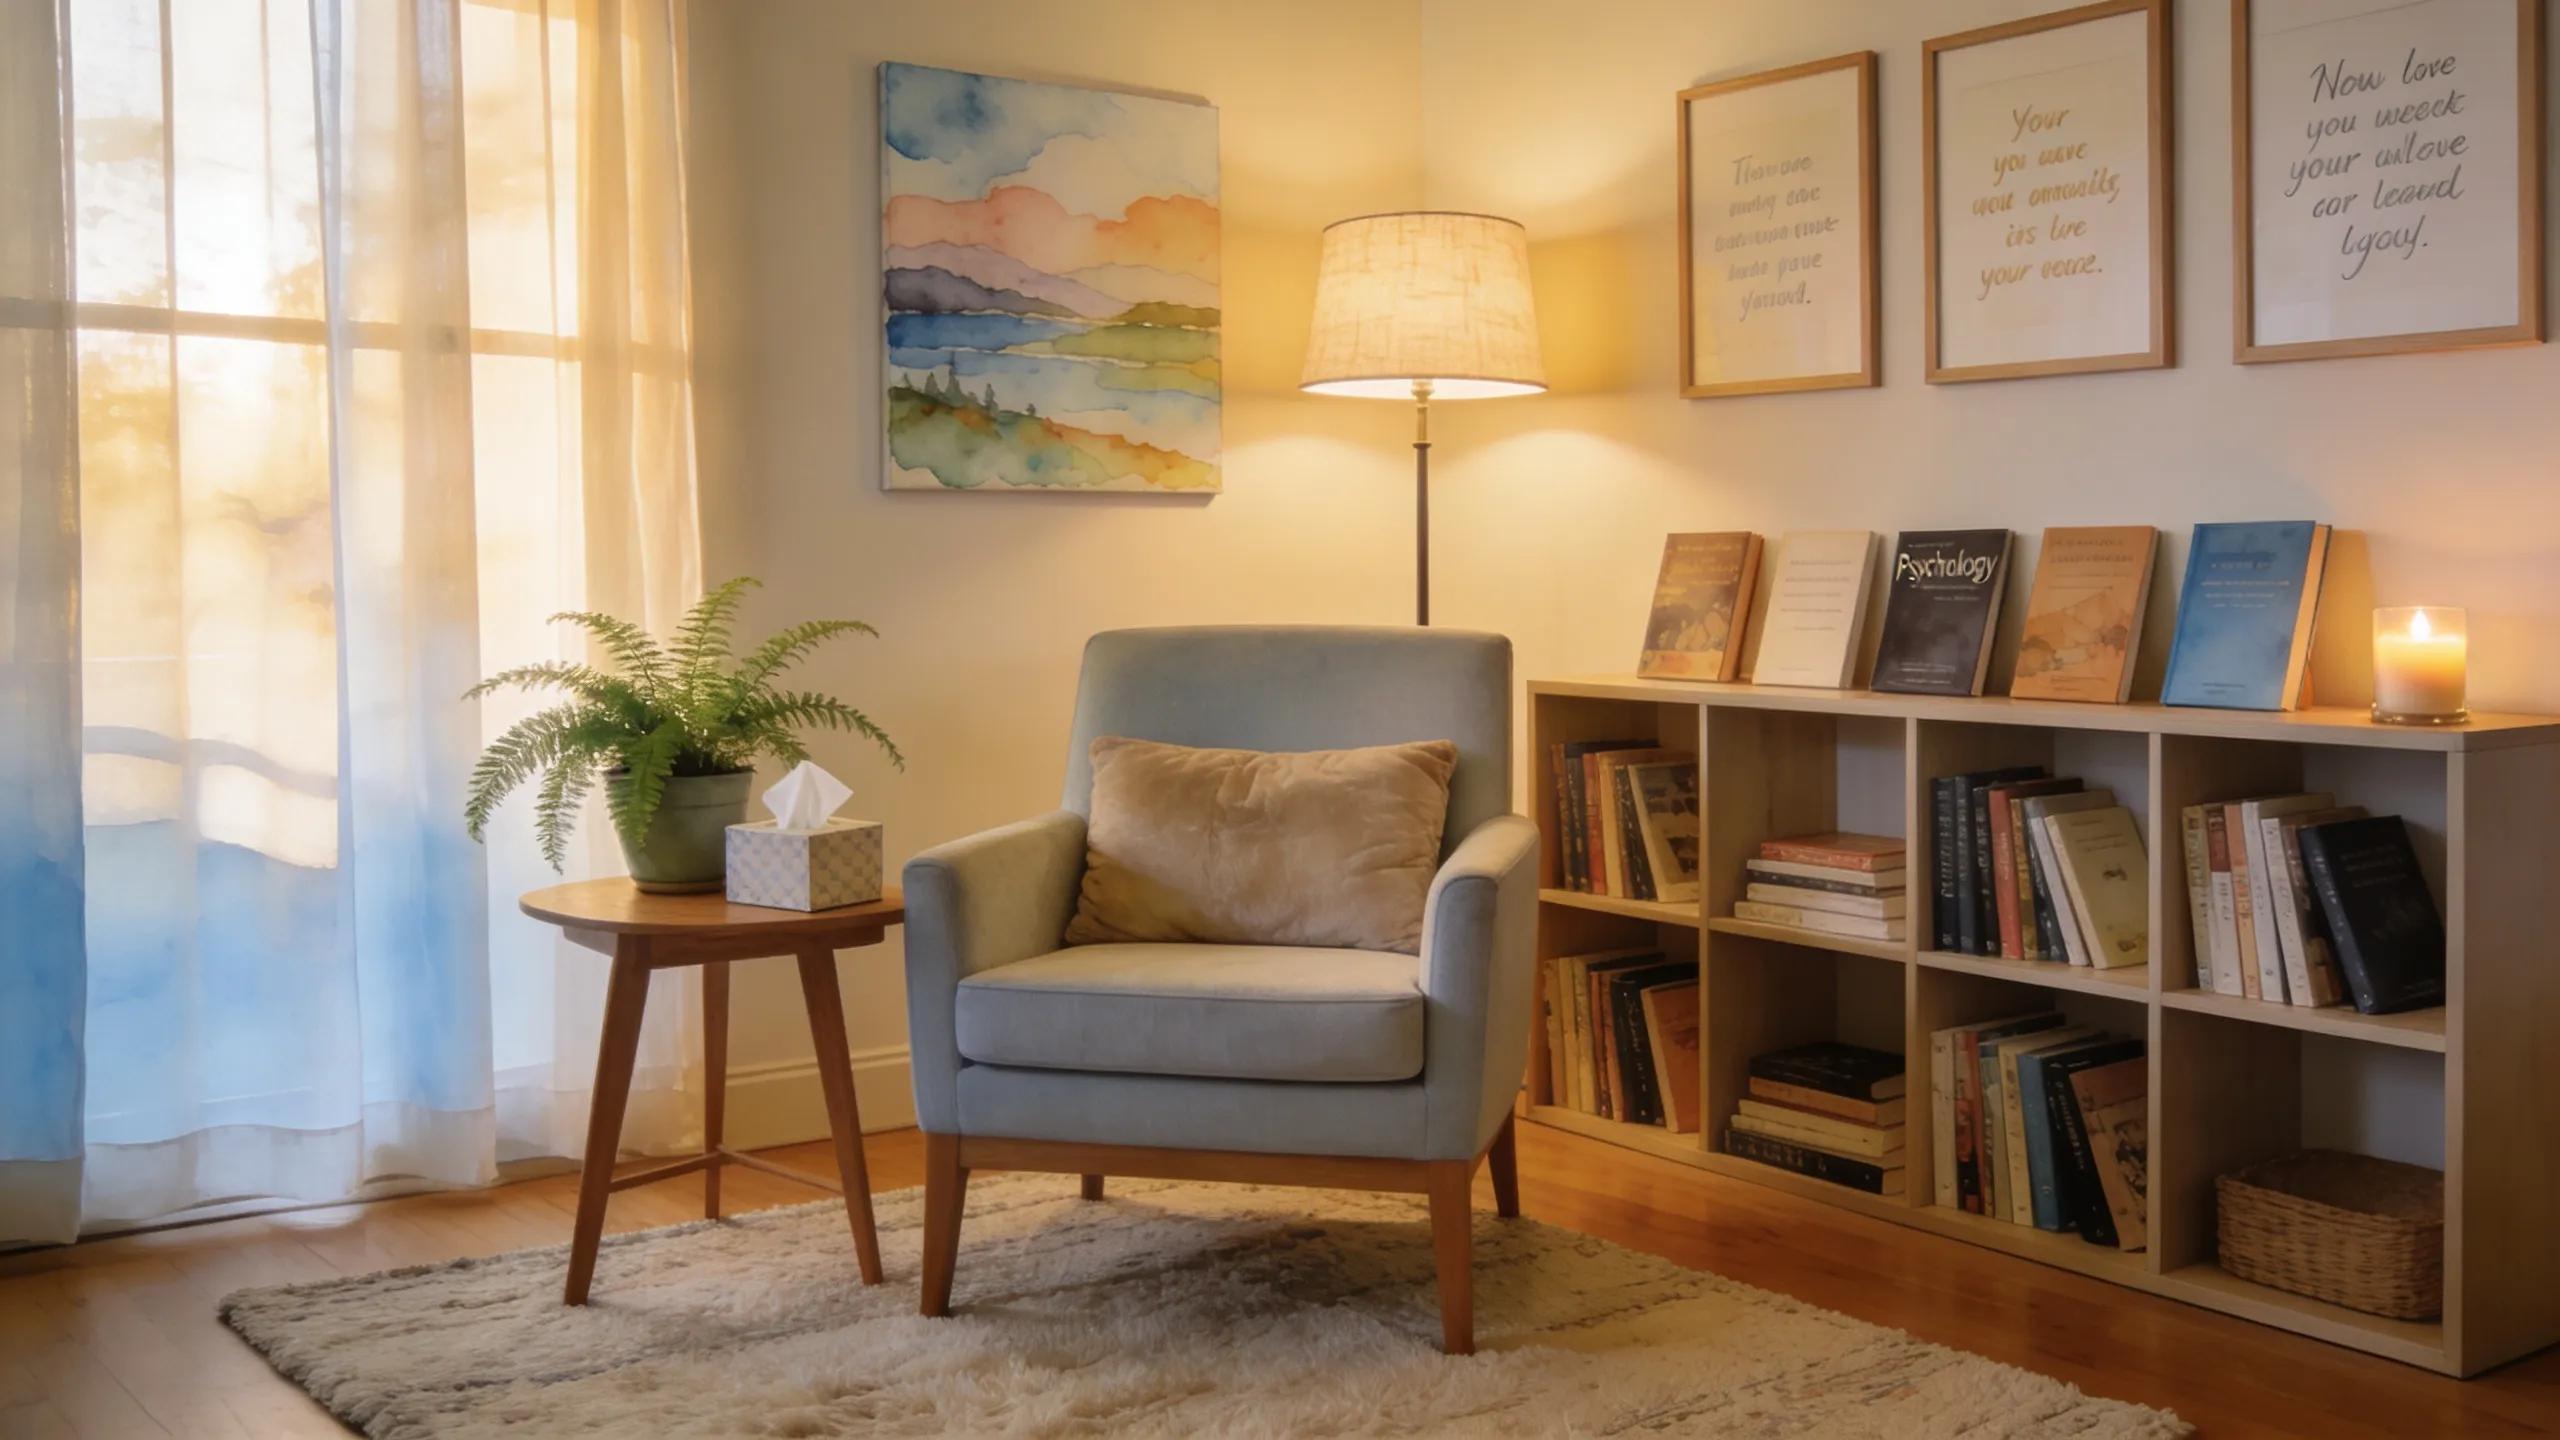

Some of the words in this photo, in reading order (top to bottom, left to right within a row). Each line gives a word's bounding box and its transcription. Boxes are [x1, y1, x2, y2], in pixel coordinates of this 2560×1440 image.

[2310, 58, 2385, 103] Now
[2402, 47, 2457, 85] love
[2011, 103, 2070, 143] Your
[2307, 114, 2357, 154] you
[2284, 152, 2362, 198] your
[1976, 263, 2034, 301] your
